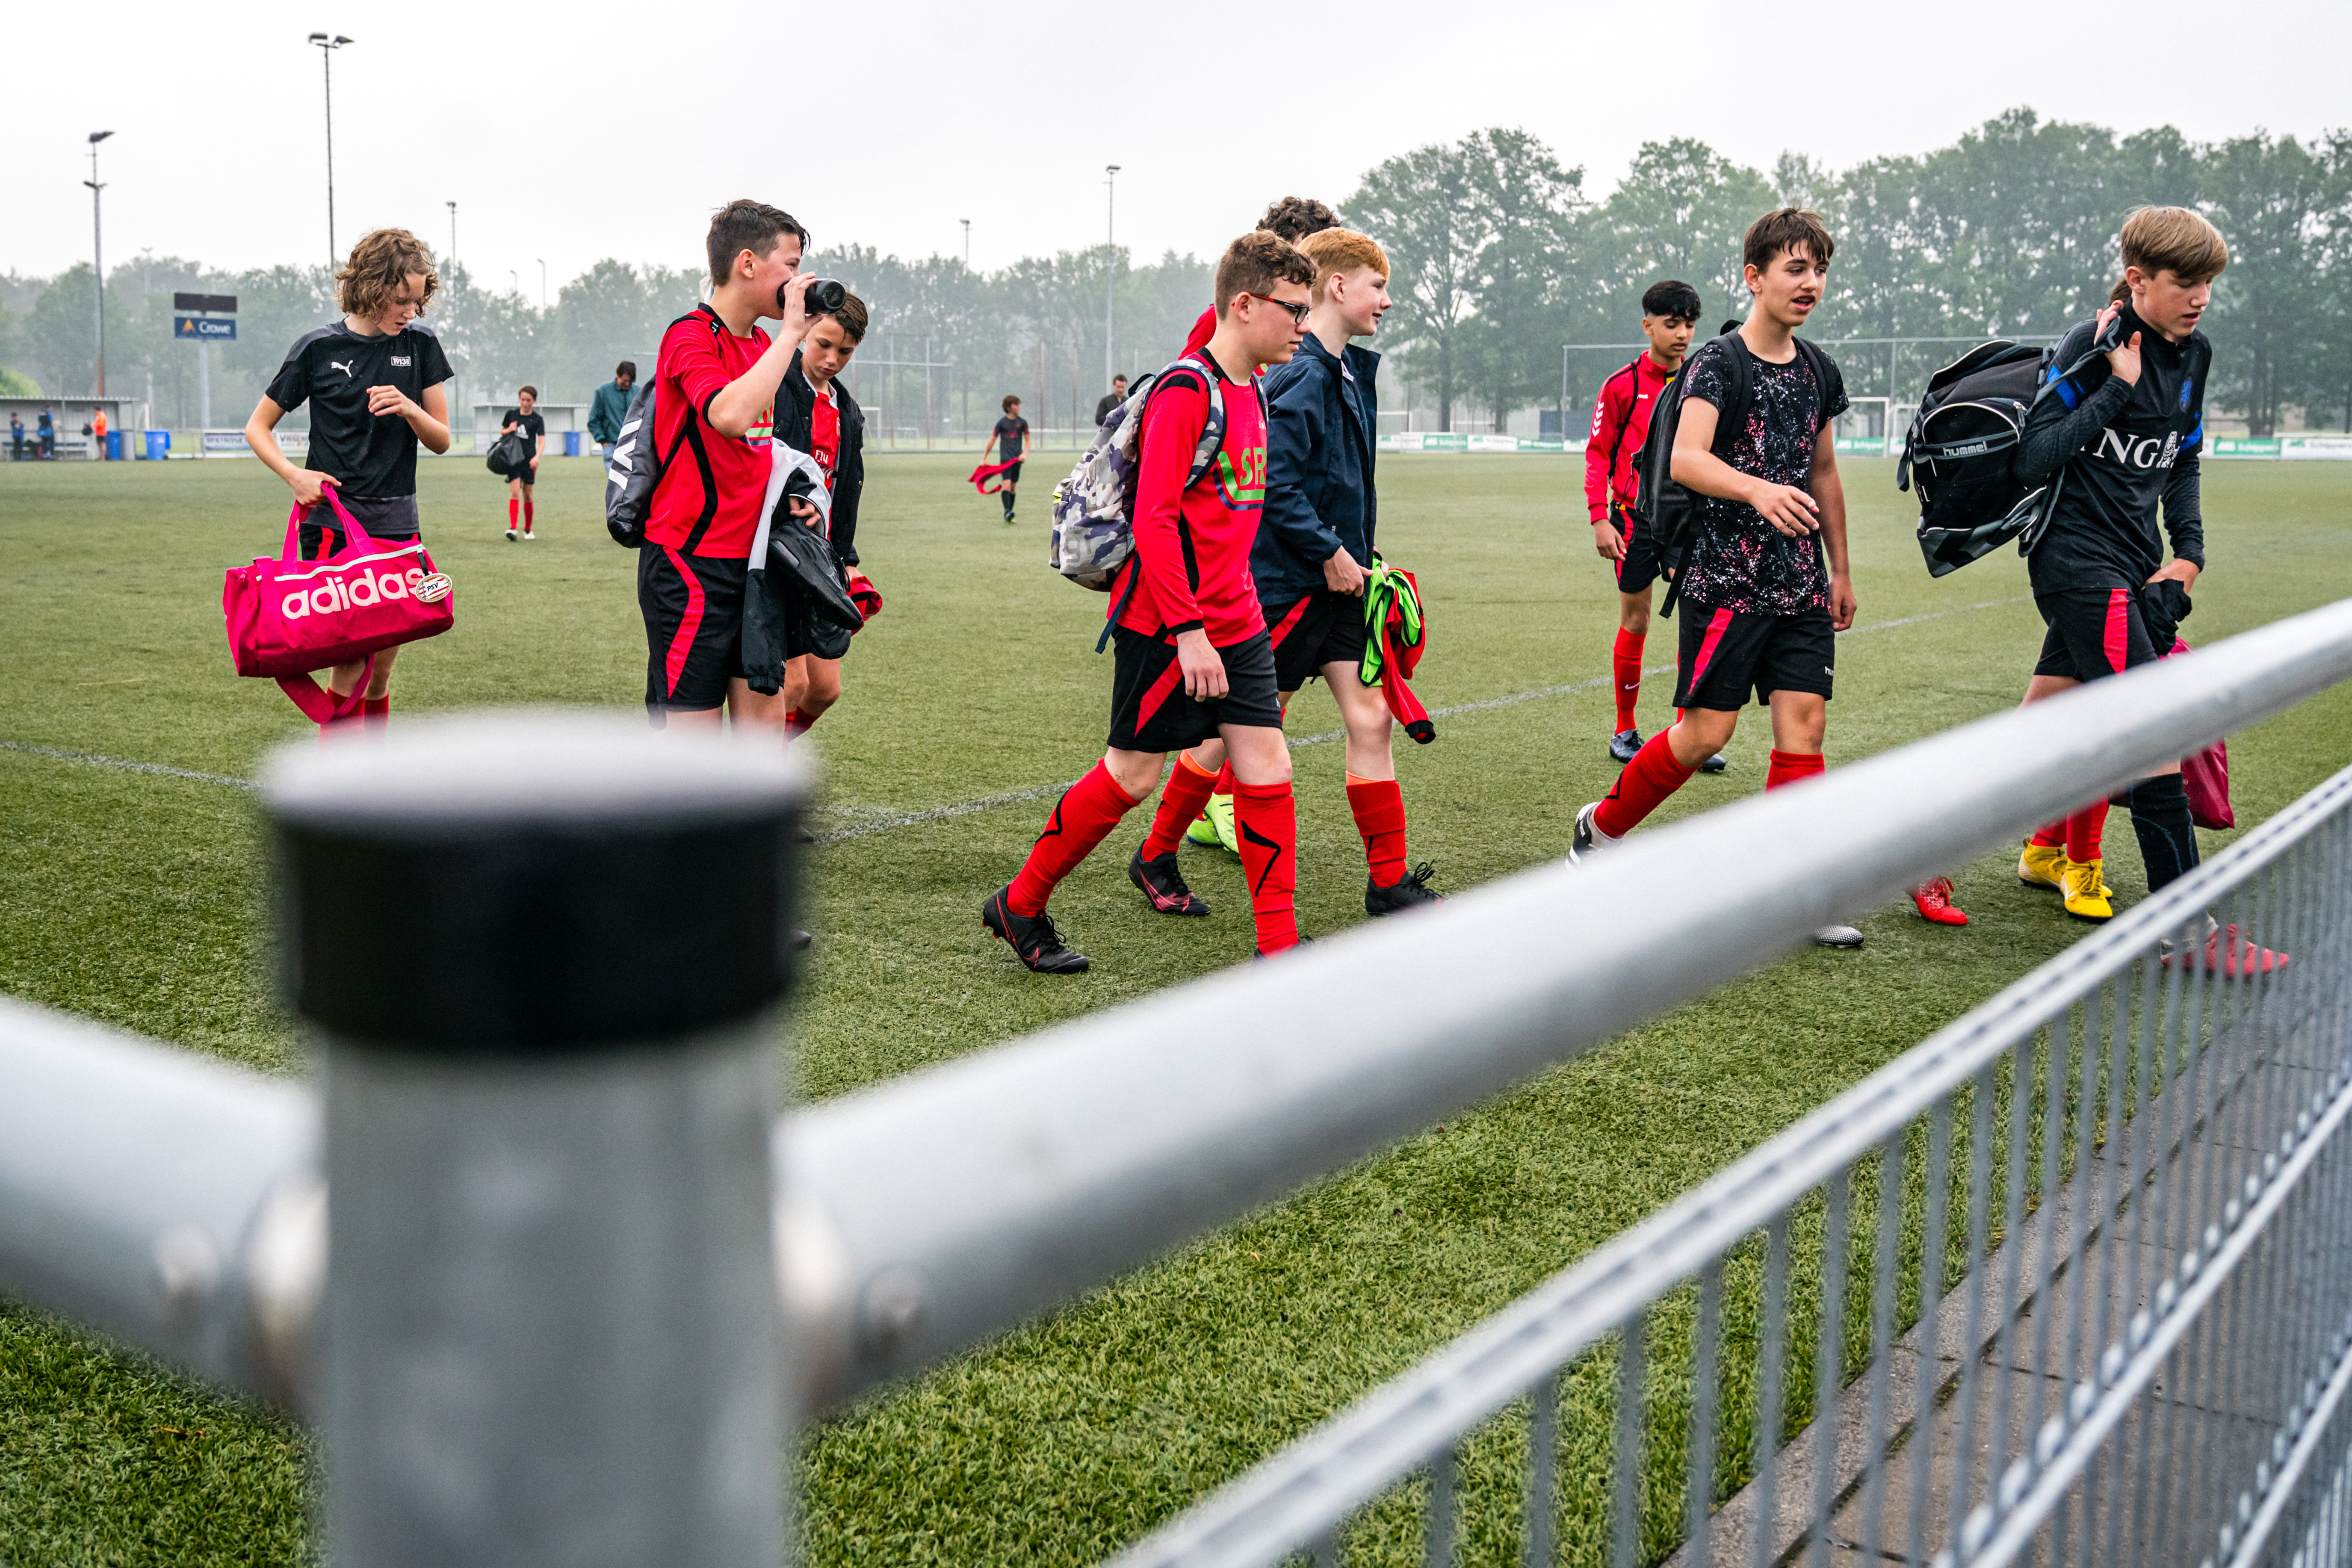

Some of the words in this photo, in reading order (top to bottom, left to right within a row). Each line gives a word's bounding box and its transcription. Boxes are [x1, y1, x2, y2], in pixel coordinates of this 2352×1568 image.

[198, 321, 231, 334] Crowe
[1943, 440, 1988, 457] hummel
[2080, 427, 2162, 469] NG
[281, 568, 425, 620] adidas
[427, 582, 438, 592] PSV
